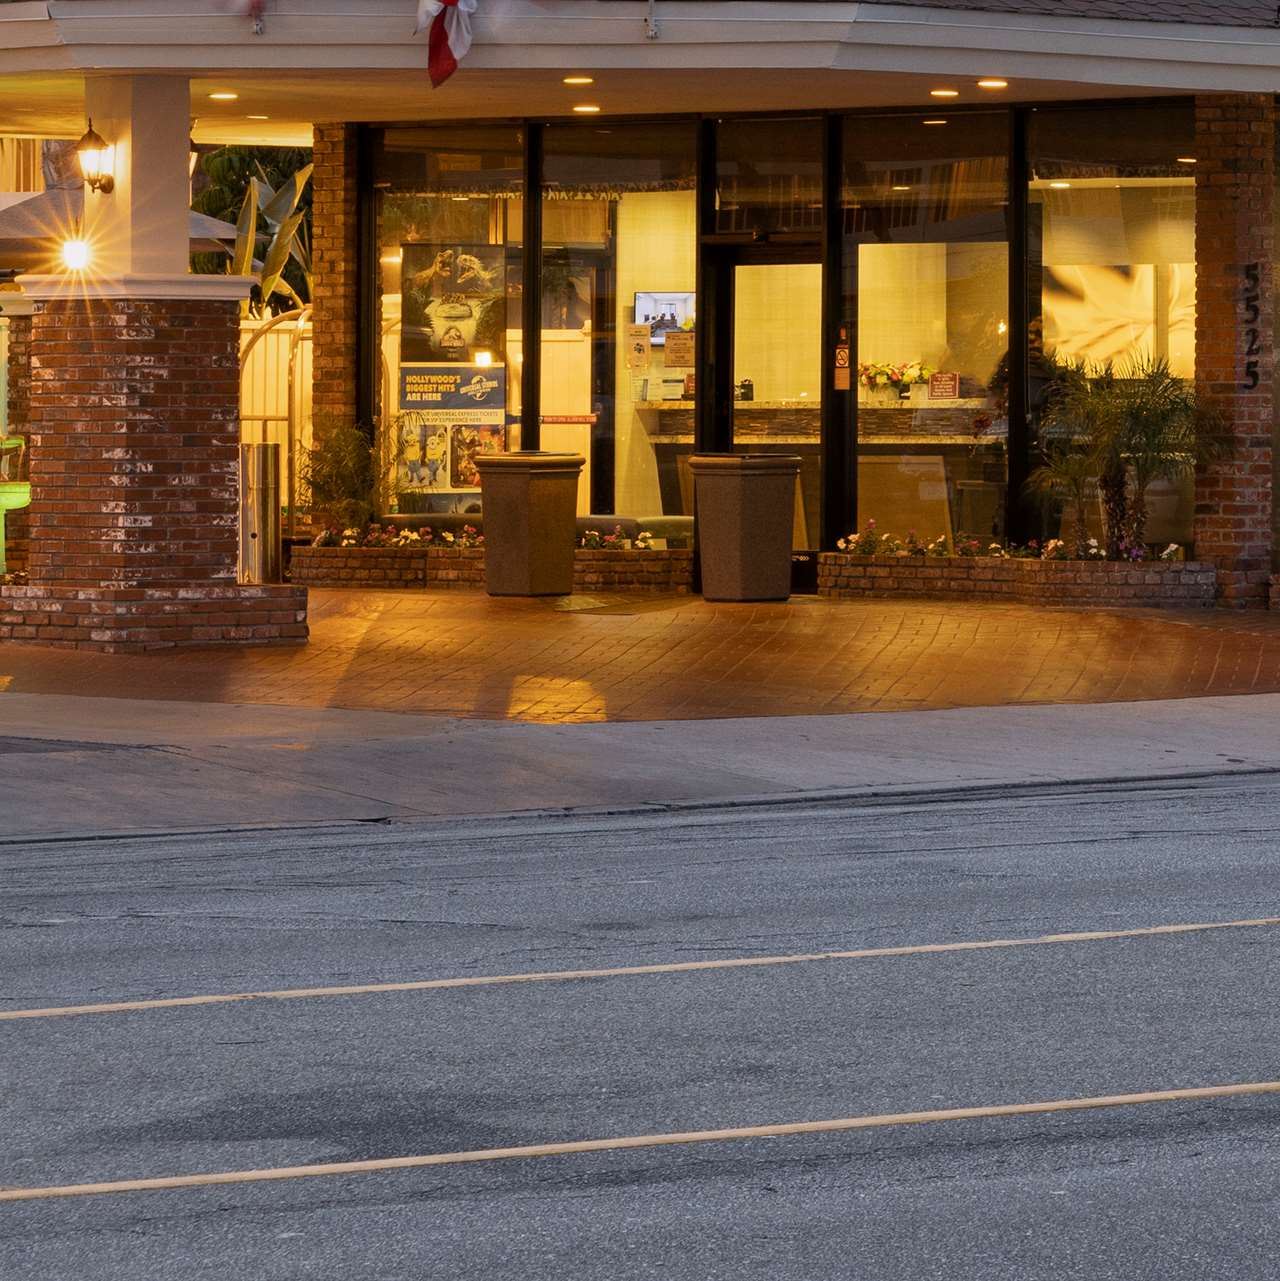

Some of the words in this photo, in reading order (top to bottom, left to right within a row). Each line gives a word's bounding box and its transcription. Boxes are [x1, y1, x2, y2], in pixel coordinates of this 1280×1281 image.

[1244, 262, 1261, 390] 5525
[406, 375, 461, 383] HOLLYWOOD'S
[406, 384, 436, 392] BIGGEST
[438, 384, 455, 392] HITS
[406, 393, 421, 401] ARE
[422, 393, 441, 401] HERE
